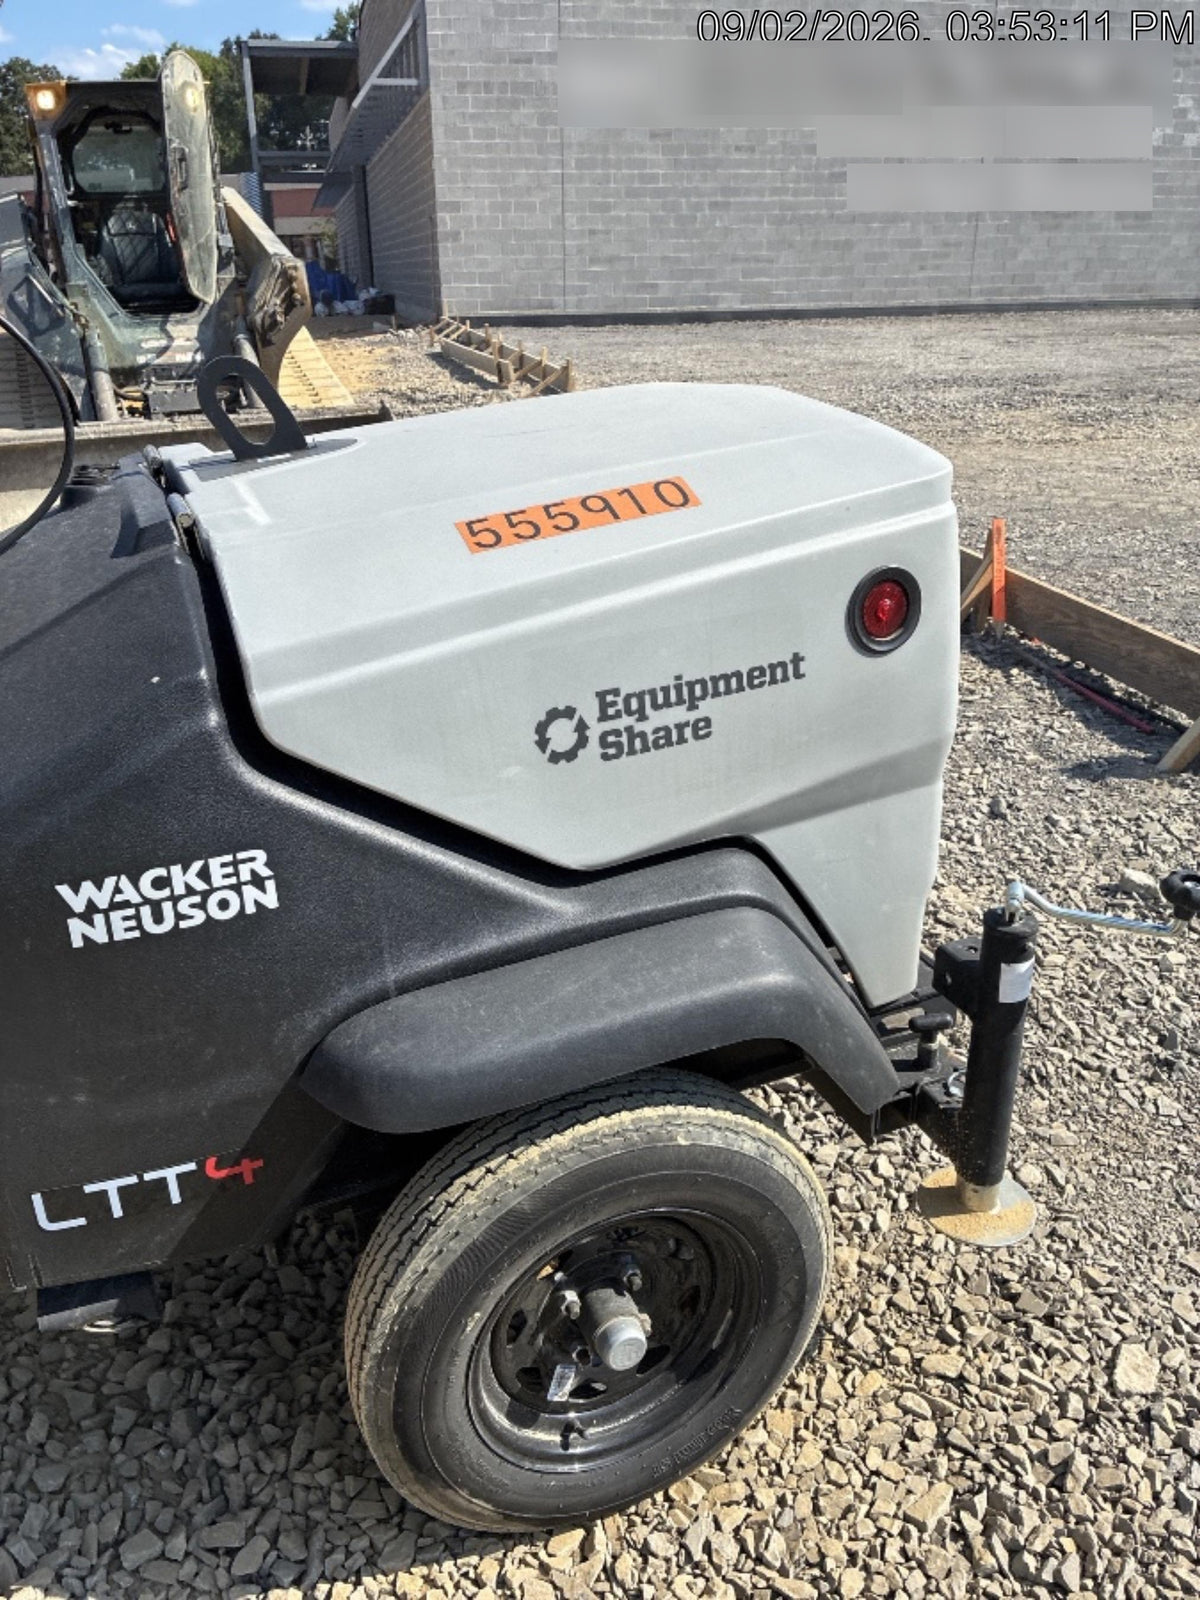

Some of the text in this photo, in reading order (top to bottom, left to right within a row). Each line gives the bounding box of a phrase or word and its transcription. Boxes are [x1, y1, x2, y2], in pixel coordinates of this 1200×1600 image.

[465, 480, 690, 548] 555910
[595, 652, 806, 723] Equipment
[598, 715, 713, 762] Share
[54, 849, 275, 913] WACKER
[66, 878, 280, 948] NEUSON
